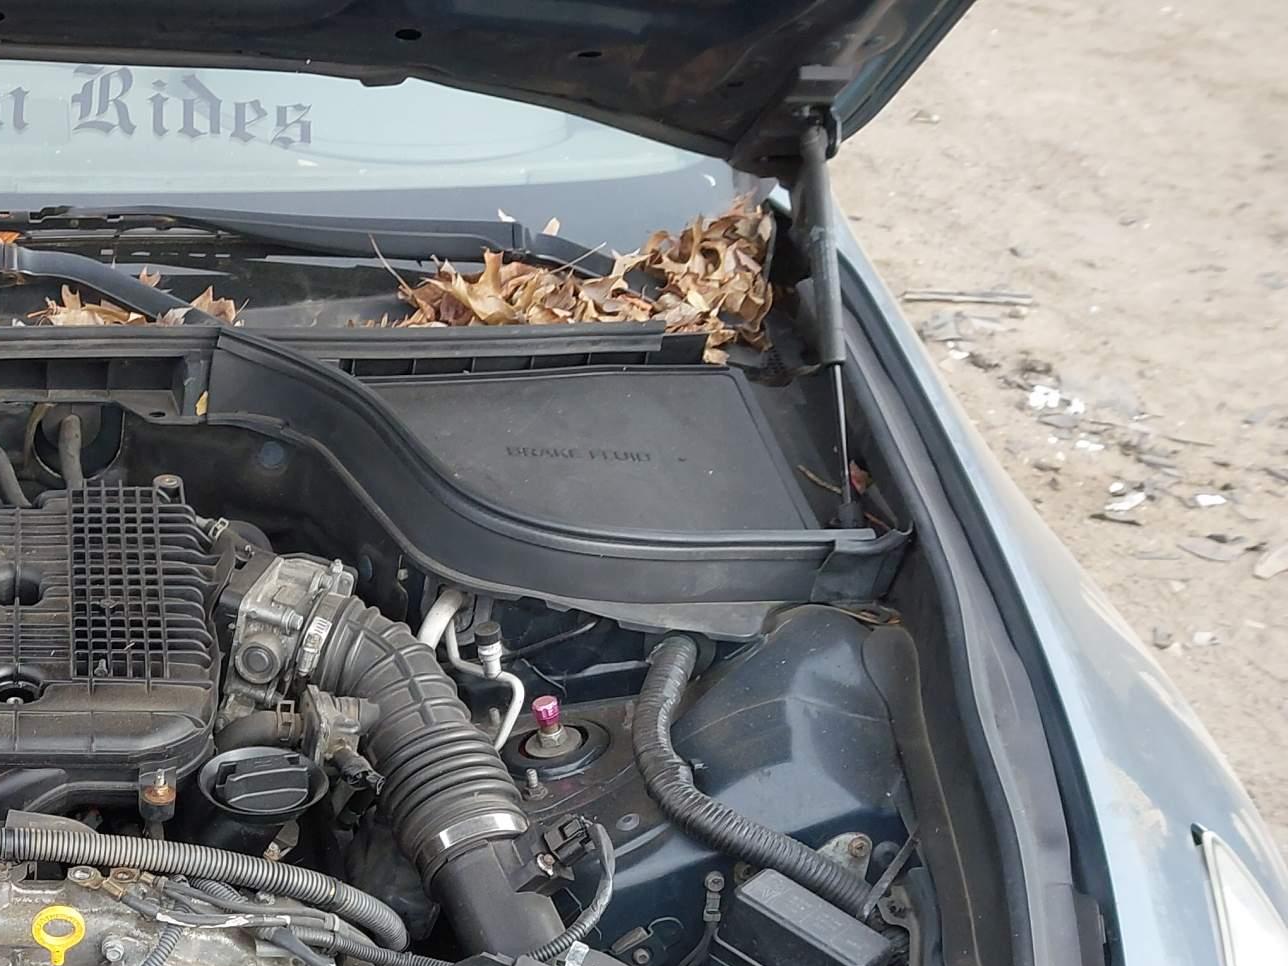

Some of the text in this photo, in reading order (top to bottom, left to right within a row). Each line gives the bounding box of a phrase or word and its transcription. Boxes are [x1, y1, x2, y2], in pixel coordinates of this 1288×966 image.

[71, 64, 313, 149] Rides
[505, 446, 652, 462] BRAKE FLUID
